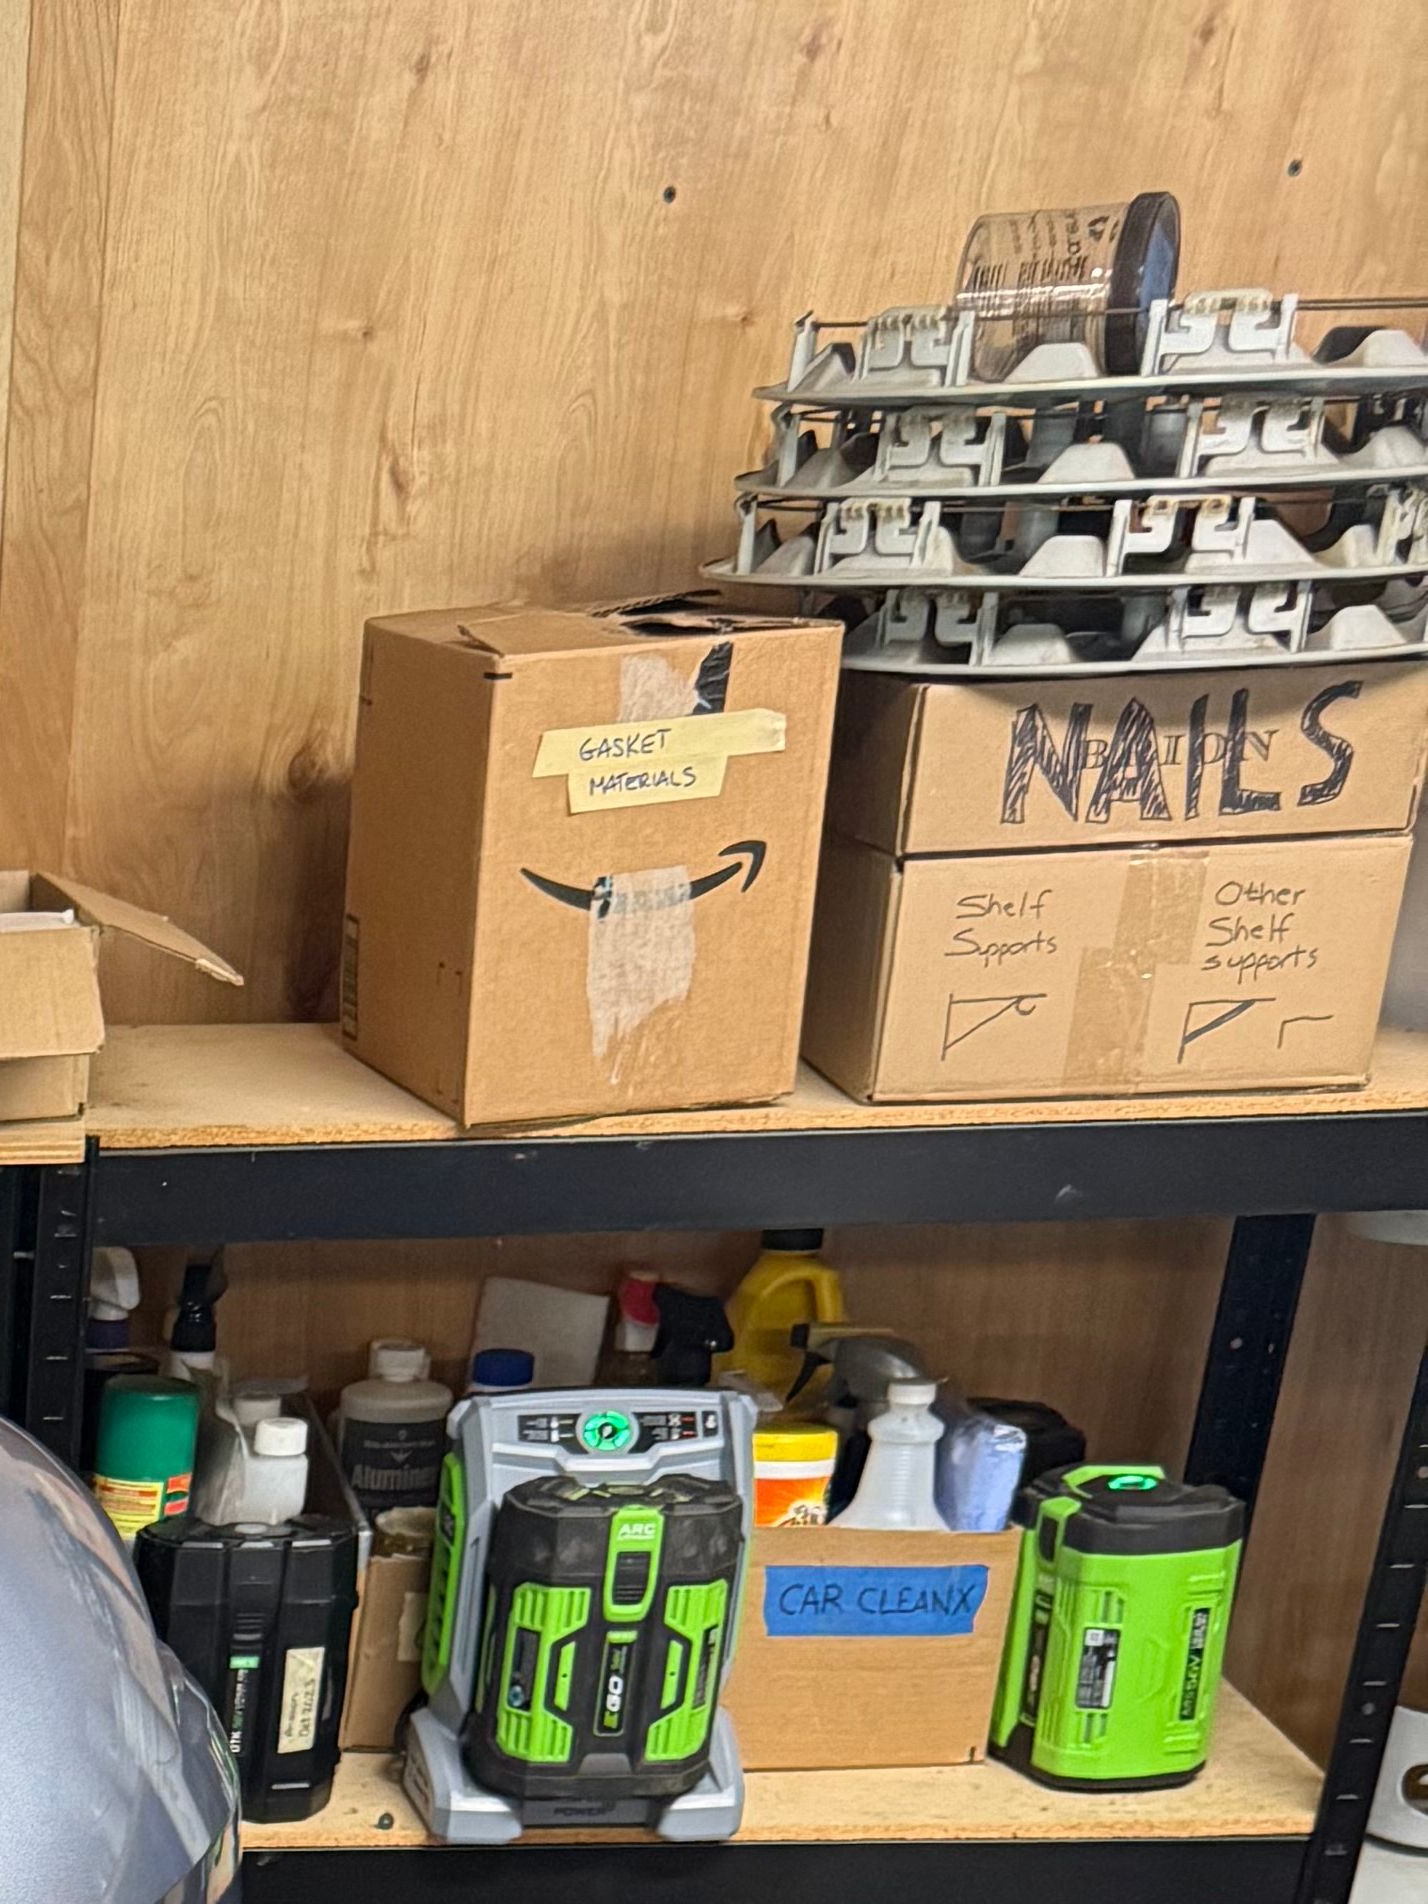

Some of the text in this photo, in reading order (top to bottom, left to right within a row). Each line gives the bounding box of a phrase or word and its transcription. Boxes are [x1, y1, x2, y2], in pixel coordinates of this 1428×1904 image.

[579, 728, 672, 761] GASKET
[1001, 680, 1364, 823] NAILS
[589, 766, 697, 796] MATERIALS
[956, 889, 1052, 920] Shelf
[1215, 881, 1307, 906] Other
[1206, 912, 1295, 946] Shelf
[945, 928, 1058, 968] Supports
[618, 1522, 658, 1537] ARC
[779, 1582, 844, 1617] CAR
